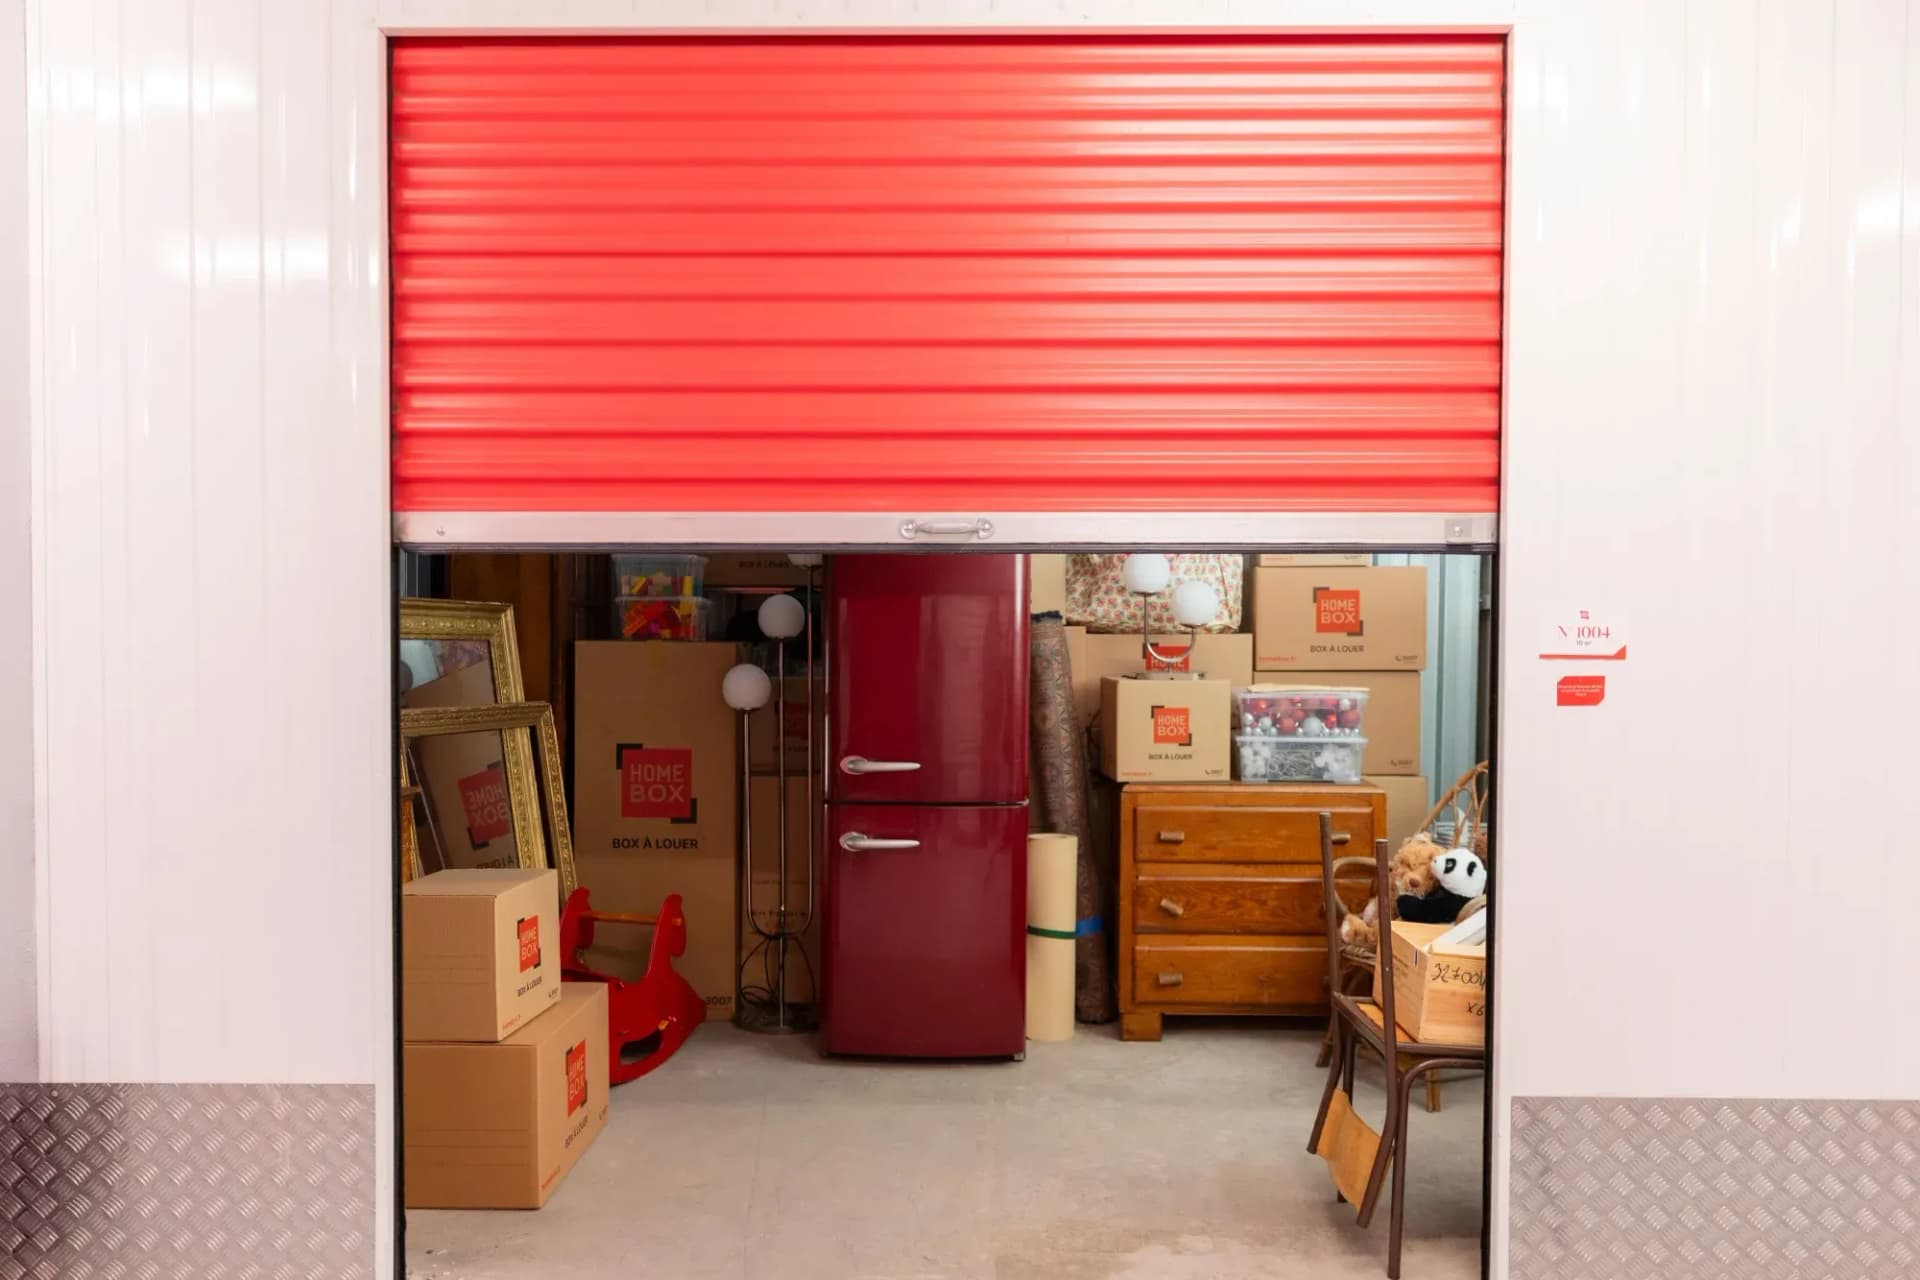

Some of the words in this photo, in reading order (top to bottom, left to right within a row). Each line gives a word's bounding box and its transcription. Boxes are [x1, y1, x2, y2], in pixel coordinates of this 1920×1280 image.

[1321, 599, 1356, 611] HOME
[1321, 611, 1356, 624] BOX
[1577, 626, 1610, 638] 1004
[1310, 645, 1327, 653] BOX
[1337, 645, 1364, 653] LOUER
[1157, 715, 1186, 726] HOME
[1157, 726, 1186, 736] BOX
[630, 764, 685, 782] HOME
[630, 784, 685, 802] BOX
[612, 838, 639, 849] BOX
[643, 834, 652, 849] À
[655, 838, 698, 849] LOUER
[520, 926, 537, 945] HOME
[521, 942, 537, 960] BOX
[569, 1075, 584, 1101] BOX
